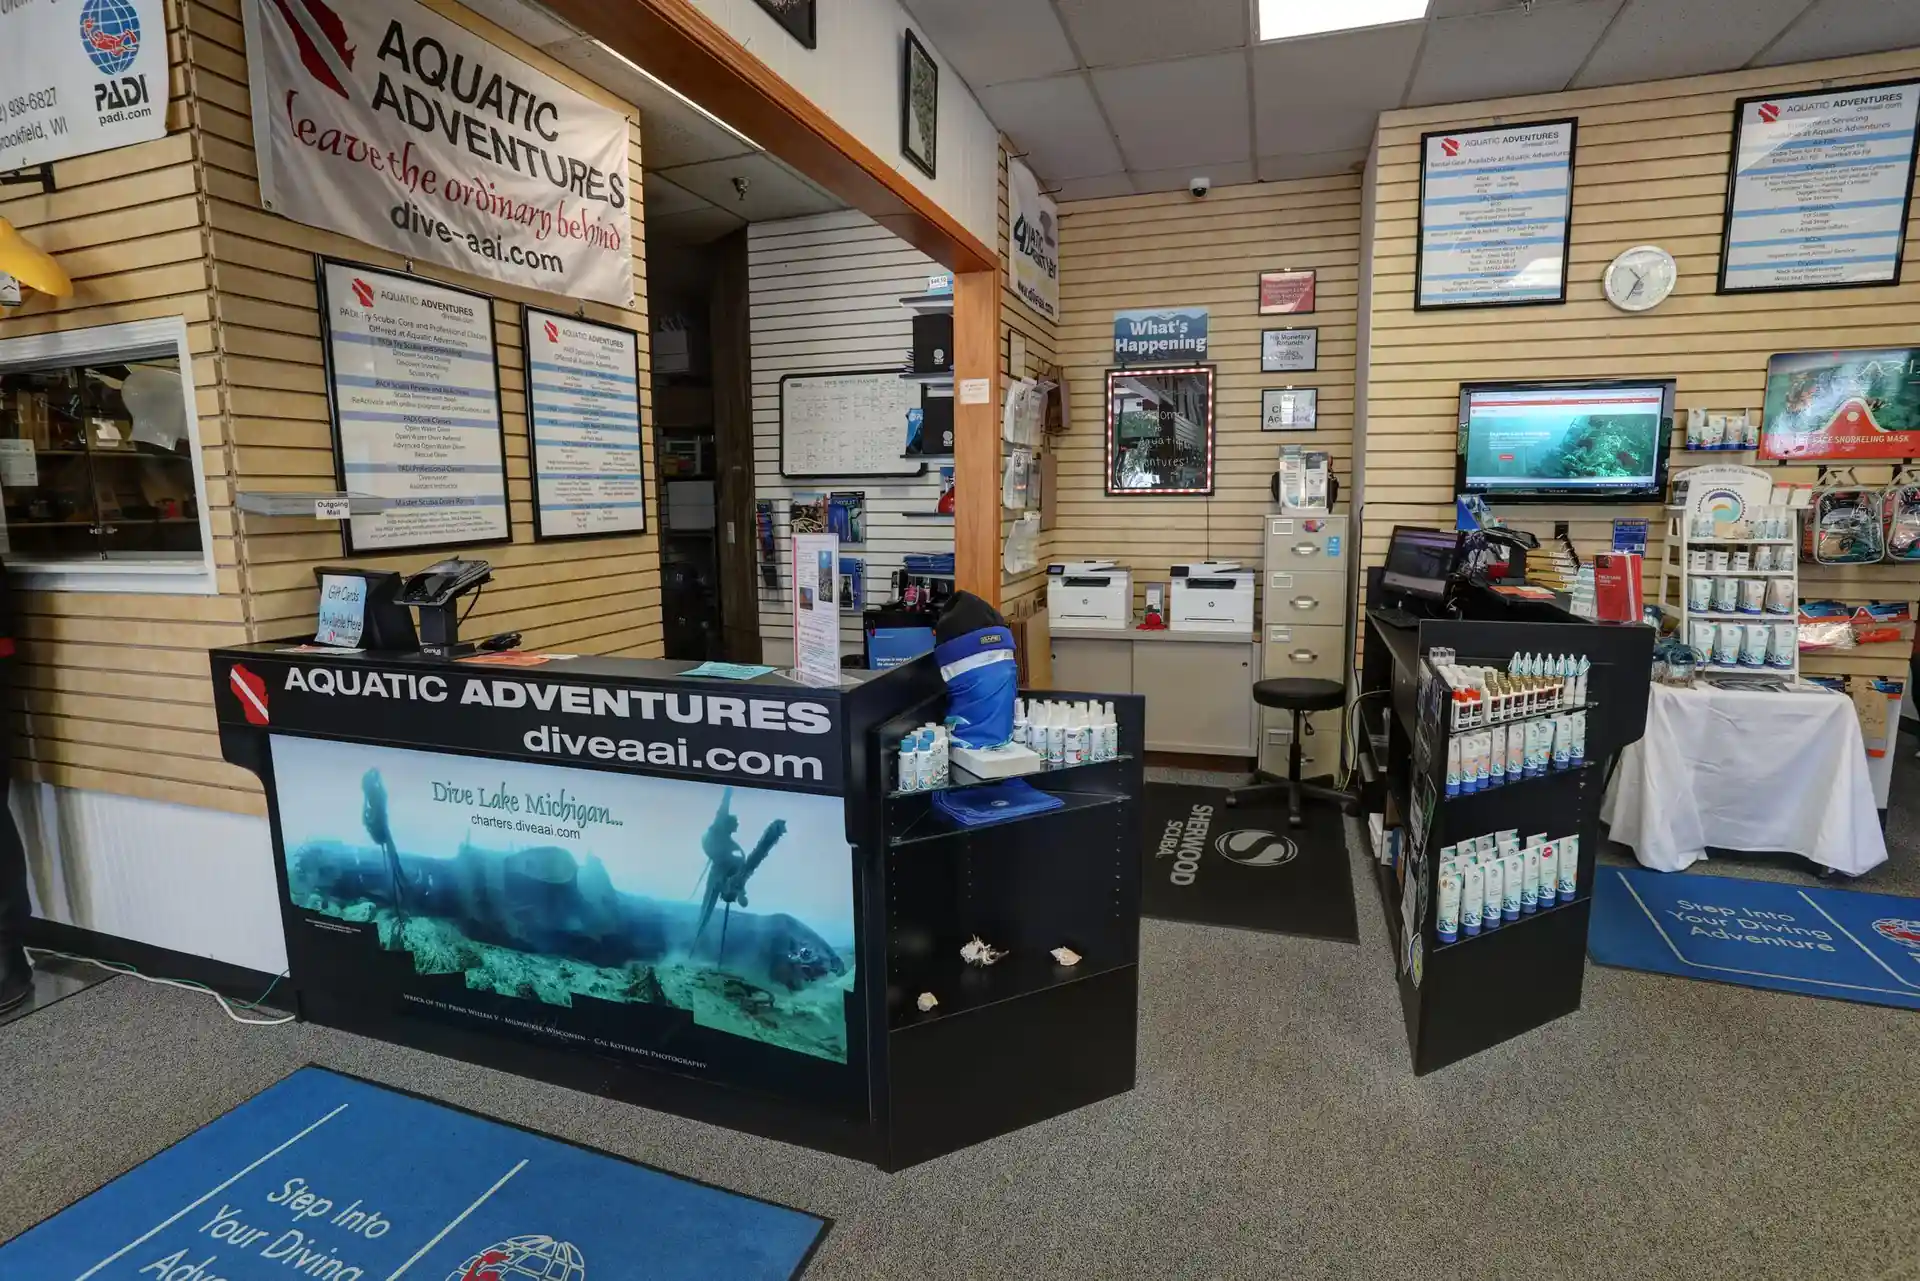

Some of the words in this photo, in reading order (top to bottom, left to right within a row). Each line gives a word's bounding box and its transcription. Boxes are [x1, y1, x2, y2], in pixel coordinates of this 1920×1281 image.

[94, 74, 149, 112] PADI
[375, 19, 560, 143] AQUATIC
[8, 86, 58, 118] 938-6827
[1786, 101, 1831, 113] AQUATIC
[1832, 93, 1903, 108] ADVENTURES
[49, 115, 69, 136] WI
[98, 108, 152, 127] padi.com
[1812, 127, 1842, 138] Aquatic
[1844, 121, 1891, 133] Adventures
[1832, 115, 1869, 125] Servicing
[370, 70, 628, 211] ADVENTURES
[1464, 137, 1501, 148] AQUATIC
[1502, 131, 1559, 144] ADVENTURES
[388, 141, 438, 195] the
[444, 176, 552, 241] ordinary
[557, 198, 621, 254] behind
[389, 200, 564, 275] dive-aai.com
[381, 290, 419, 306] AQUATIC
[421, 299, 474, 317] ADVENTURES
[562, 329, 588, 340] AQUATIC
[588, 335, 625, 349] ADVENTURES
[1129, 319, 1189, 336] What's
[1280, 333, 1311, 342] Monetary
[1115, 333, 1207, 354] Happening
[1835, 435, 1885, 445] SNORKELING
[1887, 433, 1910, 443] MASK
[317, 500, 349, 509] Outgoing
[326, 508, 341, 516] Mail
[284, 666, 448, 702] AQUATIC
[460, 679, 832, 735] ADVENTURES
[522, 725, 823, 781] diveaai.com
[431, 780, 475, 806] Dive
[478, 781, 520, 813] Lake
[524, 788, 624, 829] Michigan...
[470, 813, 581, 841] charters.diveaai.com
[1159, 819, 1184, 857] SCUBA
[1169, 803, 1214, 886] SHERWOOD
[1676, 899, 1736, 917] Step
[1742, 906, 1796, 922] Into
[1665, 909, 1729, 928] Your
[1738, 918, 1833, 941] Diving
[1689, 926, 1837, 952] Adventure
[266, 1177, 332, 1222] Step
[330, 1200, 391, 1239] Into
[199, 1204, 270, 1249] Your
